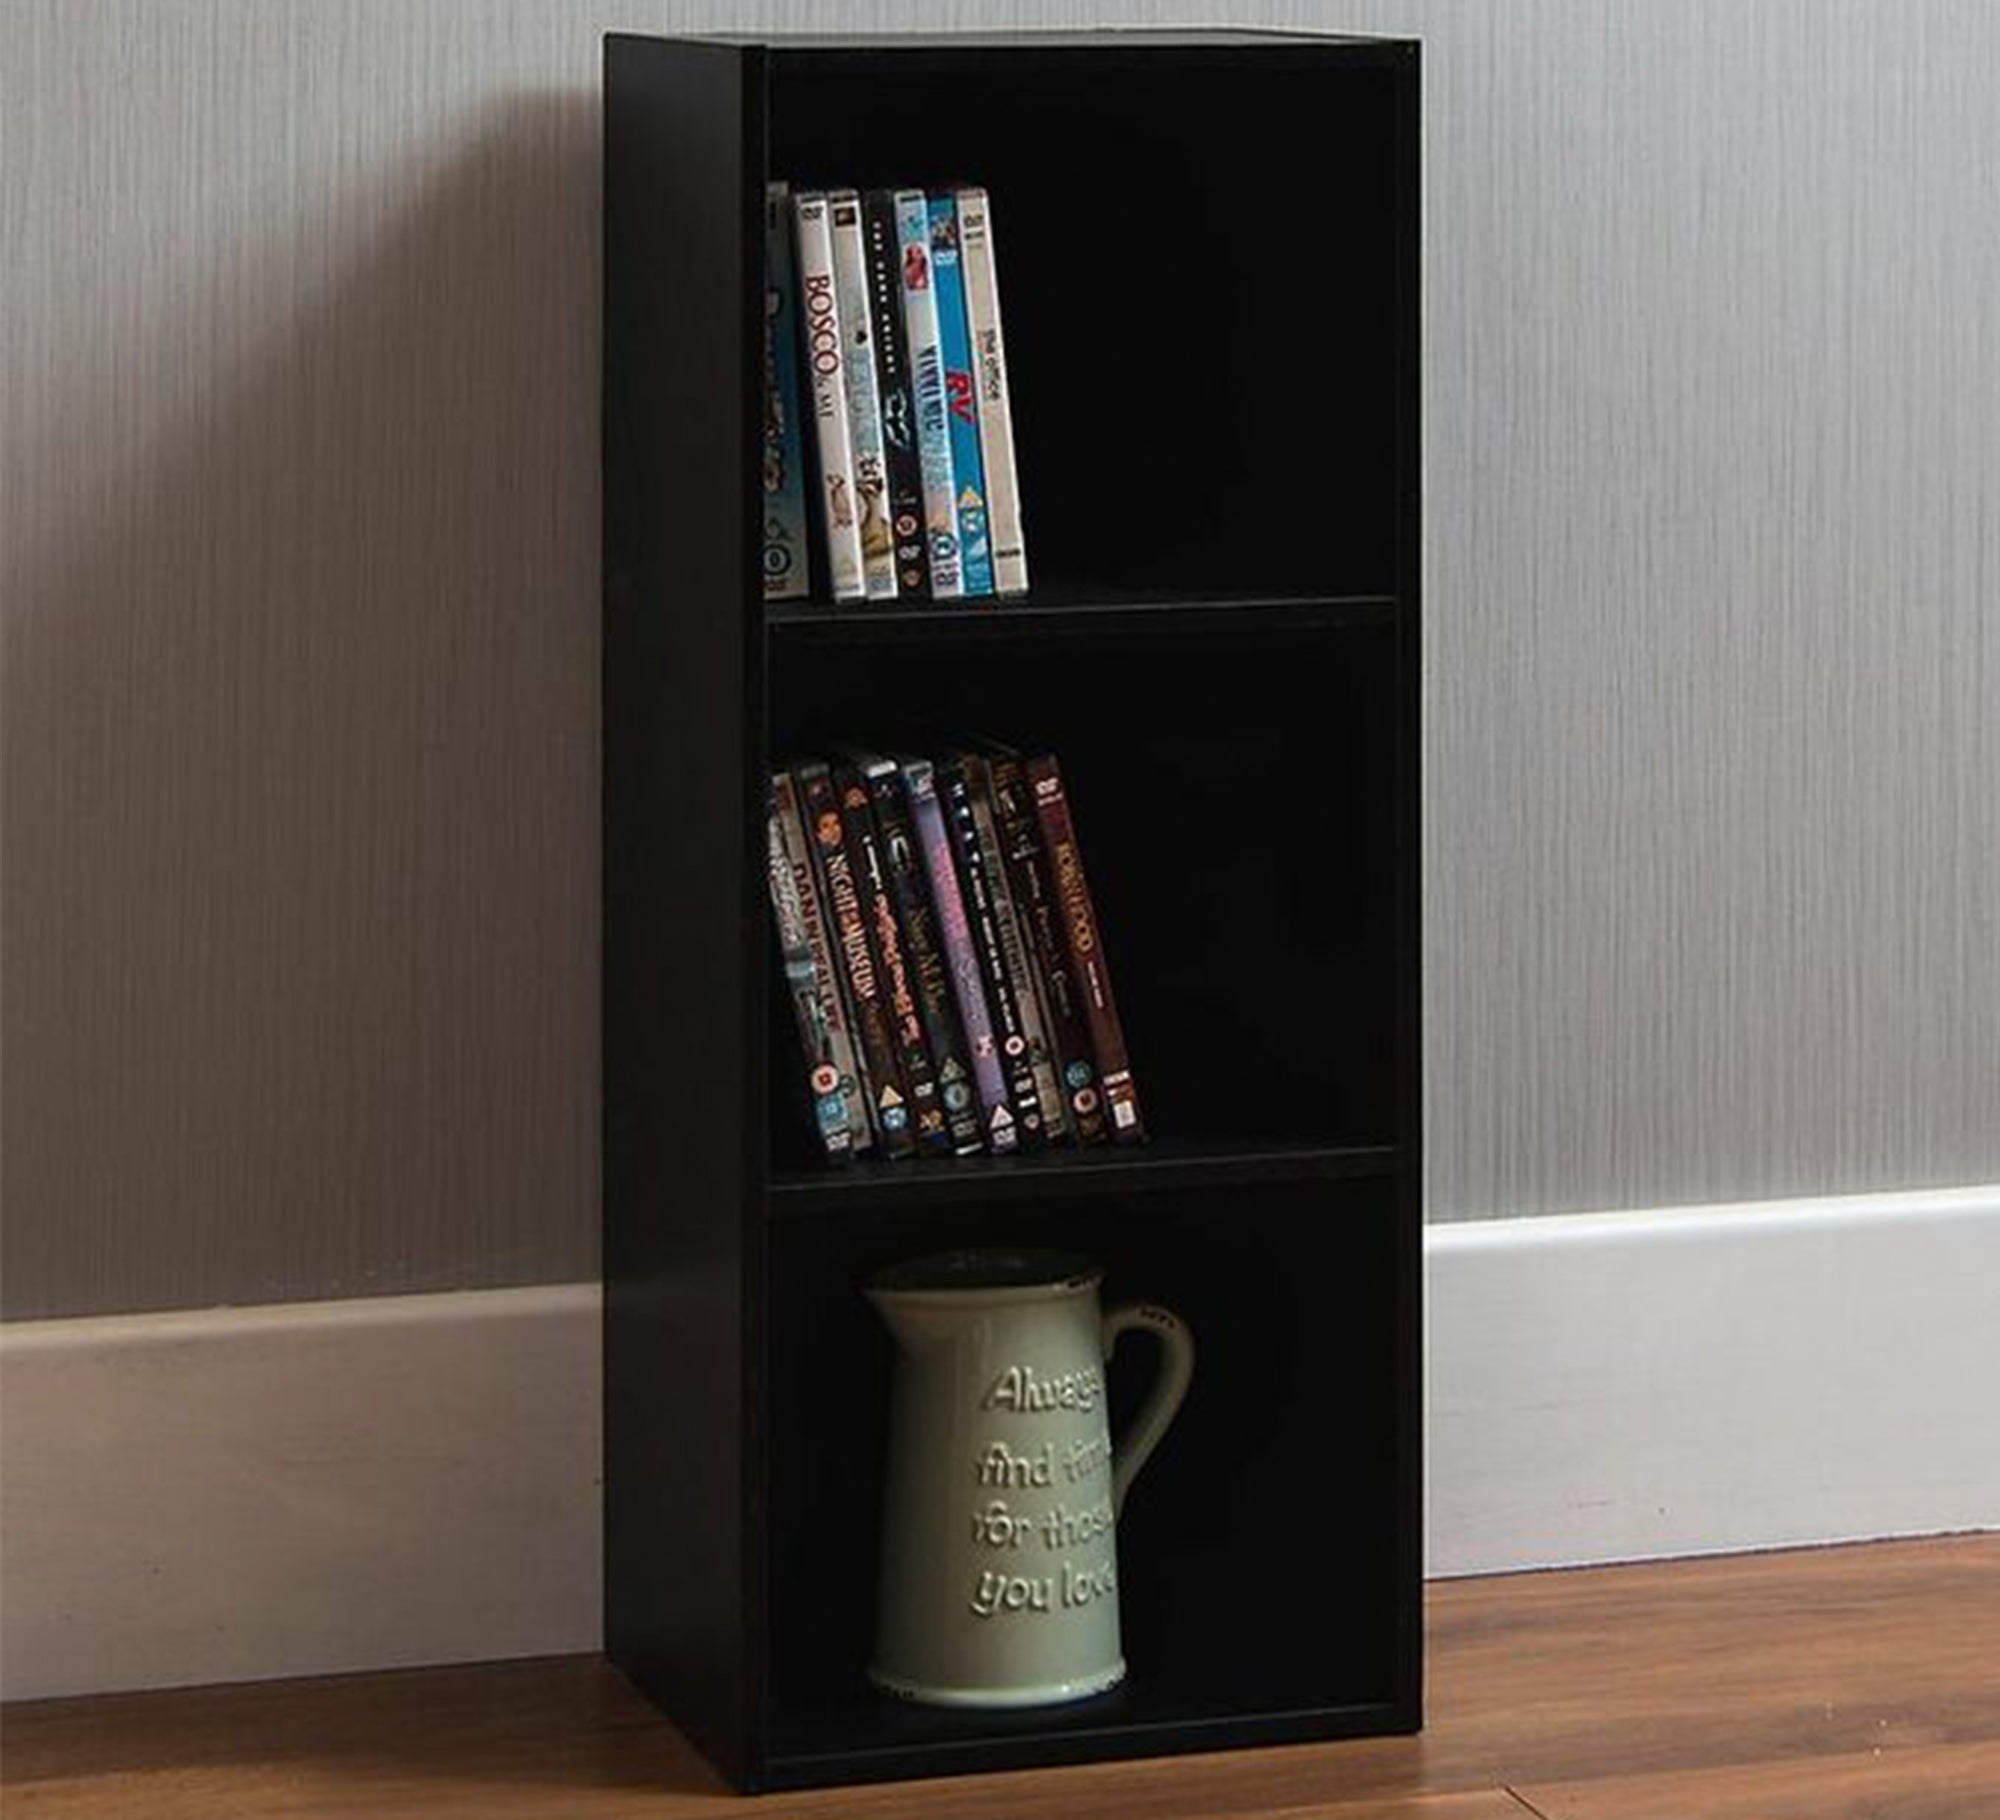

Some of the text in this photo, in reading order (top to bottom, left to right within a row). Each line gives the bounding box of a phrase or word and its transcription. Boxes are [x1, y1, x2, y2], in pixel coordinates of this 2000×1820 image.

[805, 275, 840, 375] BOSCO
[945, 369, 976, 424] RV
[972, 1500, 1031, 1548] for
[970, 1570, 1053, 1618] you
